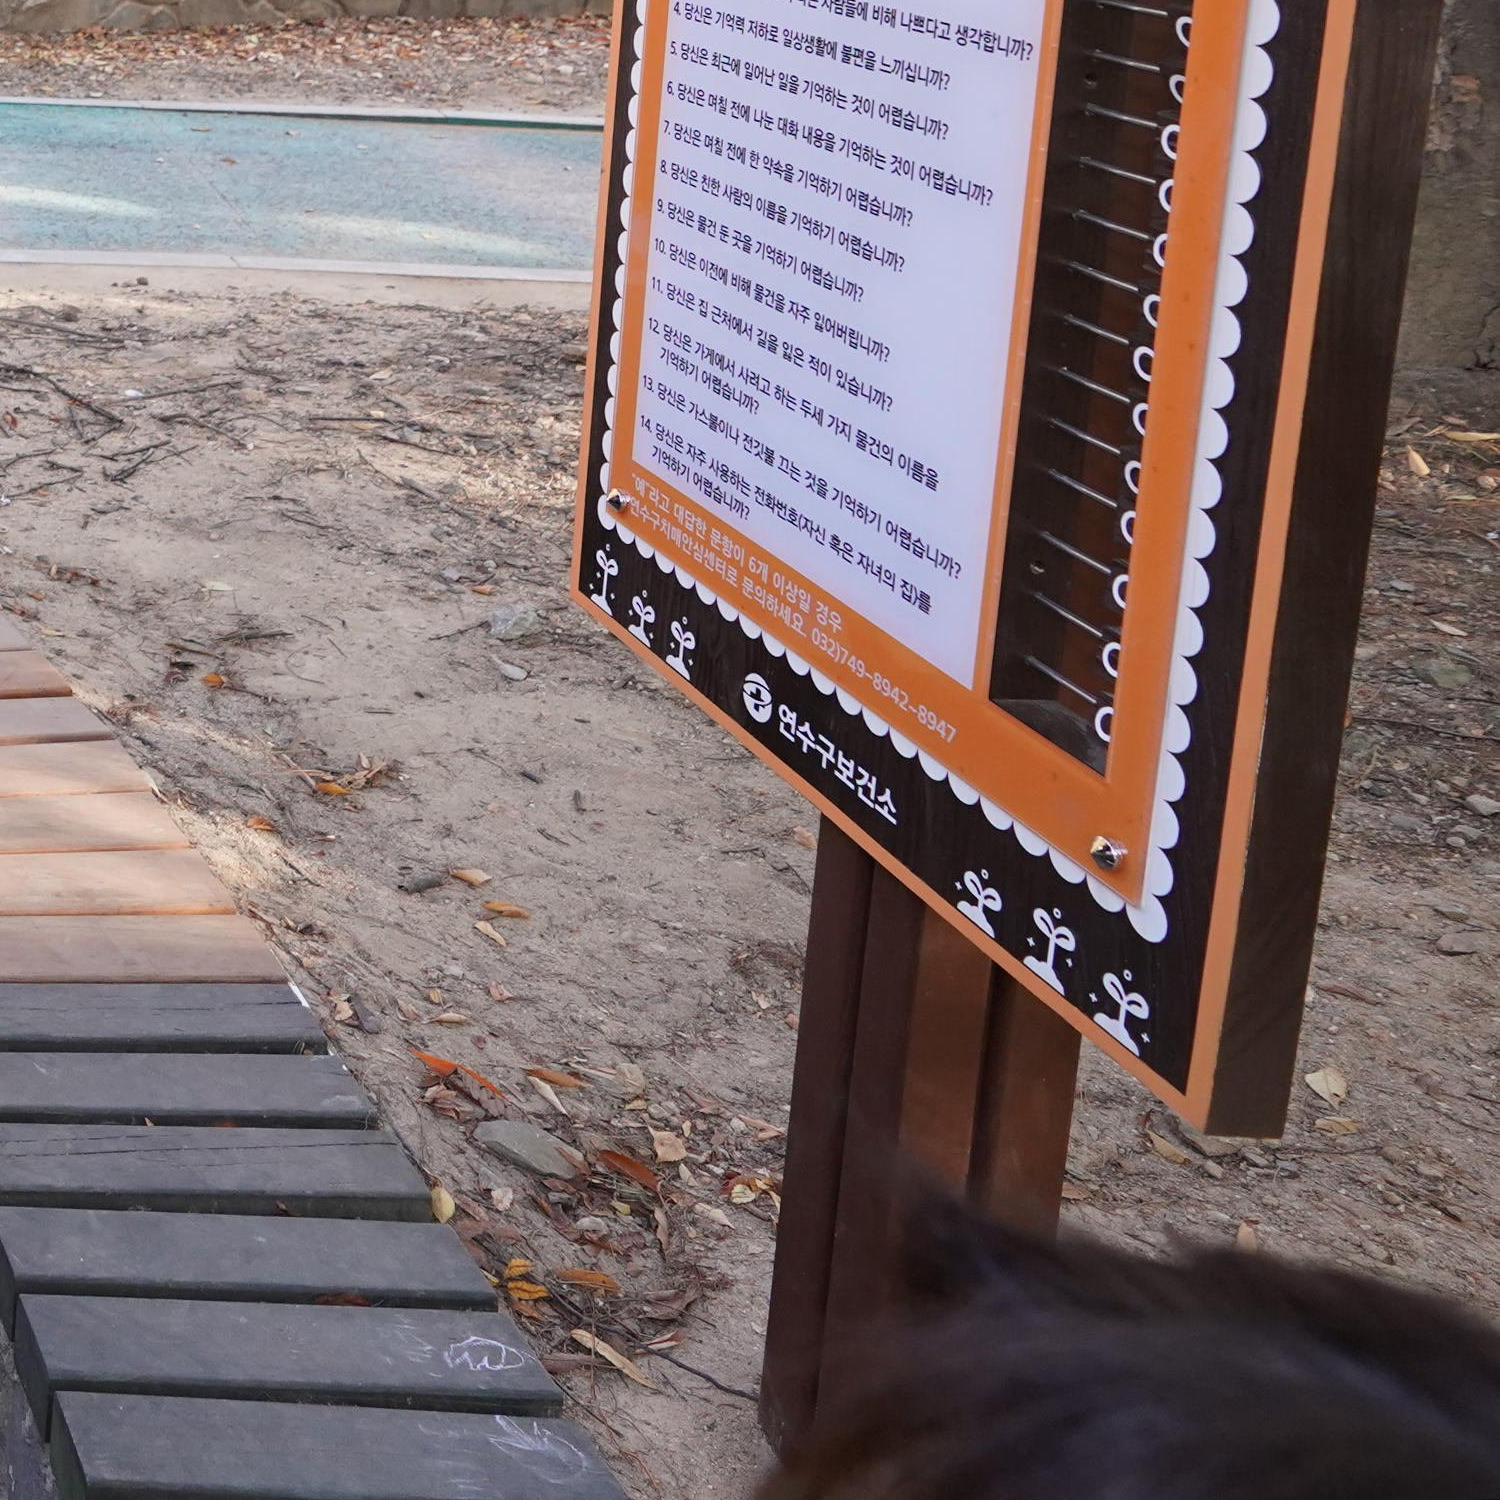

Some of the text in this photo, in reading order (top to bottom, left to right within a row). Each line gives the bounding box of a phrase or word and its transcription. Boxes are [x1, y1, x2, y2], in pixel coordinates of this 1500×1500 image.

[668, 39, 949, 141] 5. 당신은 최근에 일어난 일을 기억하는 것이 어렵습니까?
[672, 0, 951, 91] 4. 당신은 기억력 저하로 일상생활에 불편을 느끼십니까?
[870, 3, 897, 29] 비해
[899, 10, 952, 41] 나쁘다고
[953, 23, 1034, 61] 생각합니까?
[662, 118, 671, 136] 7.
[672, 121, 702, 148] 당신은
[702, 133, 724, 157] 며칠
[725, 140, 747, 166] 전에
[761, 154, 795, 184] 약속을
[796, 167, 843, 202] 기억하기
[844, 186, 914, 227] 어렵습니까?
[665, 79, 994, 207] 6. 당신은 며칠 전에 나눈 대화 내용을 기억하는 것이 어렵습니까?
[655, 197, 665, 214] 9.
[666, 200, 696, 229] 당신은
[695, 213, 717, 239] 물건
[730, 228, 753, 255] 곳을
[753, 239, 798, 275] 기억하기
[799, 259, 865, 303] 어렵습니까?
[658, 158, 906, 273] 8. 당신은 친한 사람의 이름을 기억하기 어렵습니까?
[650, 275, 664, 294] 11.
[665, 281, 696, 312] 당신은
[709, 304, 754, 342] 근처에서
[755, 327, 780, 355] 길을
[780, 340, 805, 369] 잃은
[806, 353, 832, 383] 적이
[834, 367, 893, 413] 있습니까?
[653, 236, 891, 363] 10. 당신은 이전에 비해 물건을 자주 잃어버립니까?
[658, 345, 760, 415] 기억하기 어렵습니까?
[662, 322, 693, 354] 당신은
[693, 340, 736, 378] 가게에서
[736, 364, 771, 397] 사려고
[772, 383, 798, 412] 하는
[798, 397, 825, 428] 두세
[826, 412, 852, 443] 가지
[853, 427, 894, 467] 물건의
[896, 452, 940, 492] 이름을
[639, 413, 653, 434] 14.
[654, 421, 685, 455] 당신은
[684, 441, 707, 468] 자주
[707, 456, 752, 498] 사용하는
[827, 532, 855, 565] 혹은
[855, 550, 897, 593] 자녀의
[641, 373, 962, 580] 13. 당신은 가스불이나 전깃불 끄는 것을 기억하기 어렵습니까?
[650, 443, 751, 521] 기억하기 어렵습니까?
[629, 496, 739, 588] 연수구치매안심센터로
[741, 575, 807, 638] 문의하세요.
[673, 502, 708, 541] 대답한
[709, 527, 745, 567] 문항이
[748, 556, 769, 584] 6개
[772, 571, 812, 614] 이상일
[815, 600, 843, 634] 경우
[778, 704, 897, 825] 연수구보건소
